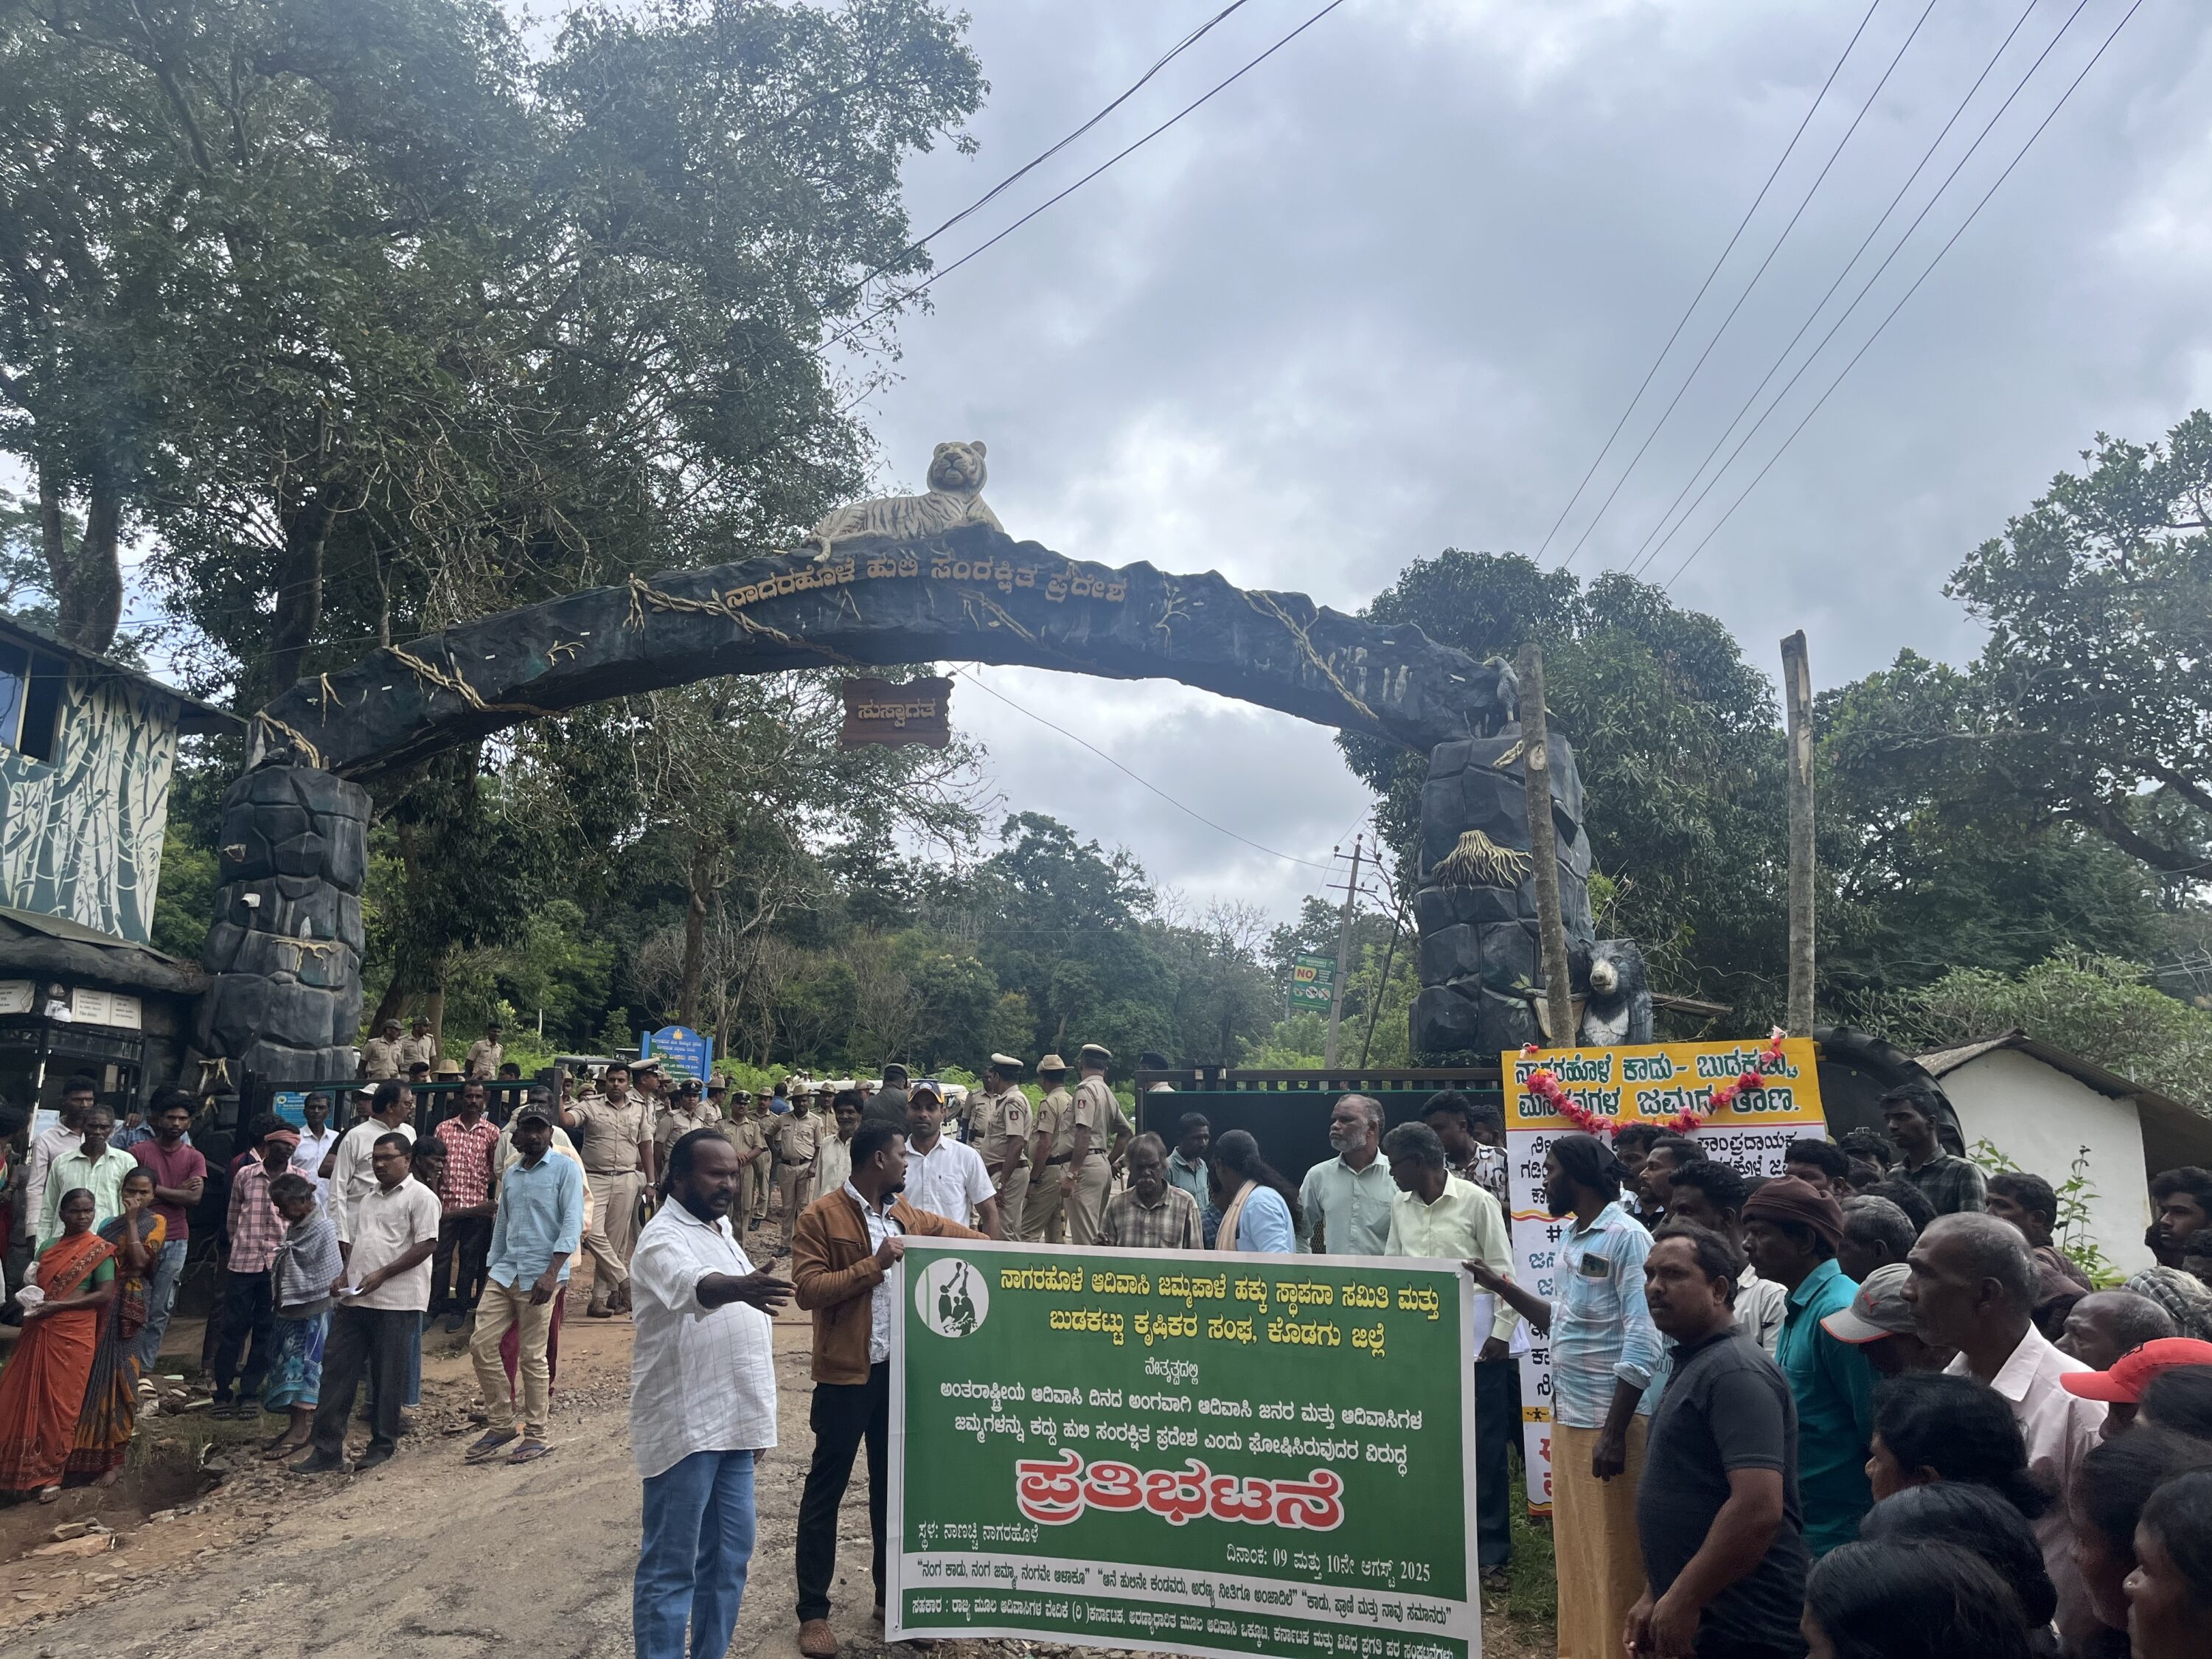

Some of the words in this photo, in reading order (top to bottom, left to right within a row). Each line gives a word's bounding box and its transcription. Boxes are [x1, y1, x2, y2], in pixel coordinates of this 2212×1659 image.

[726, 559, 855, 609] ನಾಗರಹೊಳೆ
[867, 553, 919, 579] ಹುಲಿ
[931, 554, 1037, 594] ಸಂರಕ್ಷಿತ
[1045, 568, 1127, 603] ಪ್ರದೇಶ
[858, 698, 936, 728] ಸುಸ್ವಾಗತ
[1297, 968, 1313, 978] NO
[1001, 1264, 1084, 1292] ನಾಗರಹೊಳೆ
[1091, 1272, 1150, 1295] ಆದಿವಾಸಿ
[1158, 1270, 1226, 1309] ಜಮ್ಮಪಾಳೆ
[1235, 1273, 1267, 1314] ಹಕ್ಕು
[1276, 1278, 1333, 1318] ಸ್ಥಾಪನಾ
[1342, 1281, 1389, 1308] ಸಮಿತಿ
[1398, 1284, 1439, 1320] ಮತ್ತು
[1050, 1306, 1124, 1346] ಬುಡಕಟ್ಟು
[1134, 1309, 1198, 1346] ಕೃಷಿಕರ
[1208, 1314, 1257, 1344] ಸಂಘ,
[1268, 1316, 1340, 1346] ಕೊಡಗು
[1352, 1323, 1385, 1357] ಜಿಲ್ಲೆ
[1145, 1357, 1198, 1385] ನೇತೃತ್ವದಲ್ಲಿ
[940, 1380, 1026, 1412] ಅಂತರಾಷ್ಟ್ರೀಯ
[1032, 1386, 1082, 1405] ಆದಿವಾಸಿ
[1089, 1388, 1122, 1408] ದಿನದ
[1129, 1392, 1192, 1413] ಅಂಗವಾಗಿ
[1198, 1398, 1252, 1418] ಆದಿವಾಸಿ
[1259, 1400, 1294, 1420] ಜನರ
[1301, 1402, 1335, 1429] ಮತ್ತು
[1341, 1407, 1422, 1430] ಆದಿವಾಸಿಗಳ
[955, 1413, 1025, 1443] ಜಮ್ಮಗಳನ್ನು
[1031, 1416, 1057, 1446] ಕದ್ದು
[1062, 1419, 1090, 1439] ಹುಲಿ
[1096, 1422, 1150, 1451] ಸಂರಕ್ಷಿತ
[1156, 1426, 1198, 1450] ಪ್ರದೇಶ
[1204, 1431, 1242, 1450] ಎಂದು
[1249, 1432, 1359, 1461] ಘೋಷಿಸಿರುವುದರ
[1366, 1443, 1408, 1478] ವಿರುದ್ಧ
[1016, 1448, 1344, 1531] ಪ್ರತಿಭಟನೆ
[918, 1520, 939, 1551] ಸ್ಥಳ:
[983, 1522, 1039, 1543] ನಾಗರಹೊಳೆ
[972, 1560, 990, 1577] ನಂಗ
[1358, 1597, 1378, 1622] ಮತ್ತು
[1382, 1601, 1403, 1622] ನಾವು
[1226, 1543, 1267, 1565] ದಿನಾಂಕ:
[1273, 1548, 1287, 1567] 09
[1293, 1550, 1322, 1580] ಮತ್ತು
[1327, 1554, 1354, 1575] 10ನೇ
[1361, 1557, 1396, 1588] ಆಗಸ್ಟ್
[1400, 1561, 1431, 1582] 2025
[912, 1595, 942, 1614] ಸಹಕಾರ
[952, 1599, 970, 1622] ರಾಜ್ಯ
[974, 1595, 997, 1613] ಮೂಲ
[1273, 1624, 1310, 1646] ಕರ್ನಾಟಕ
[1313, 1629, 1334, 1655] ಮತ್ತು
[1386, 1638, 1400, 1658] ಪರ
